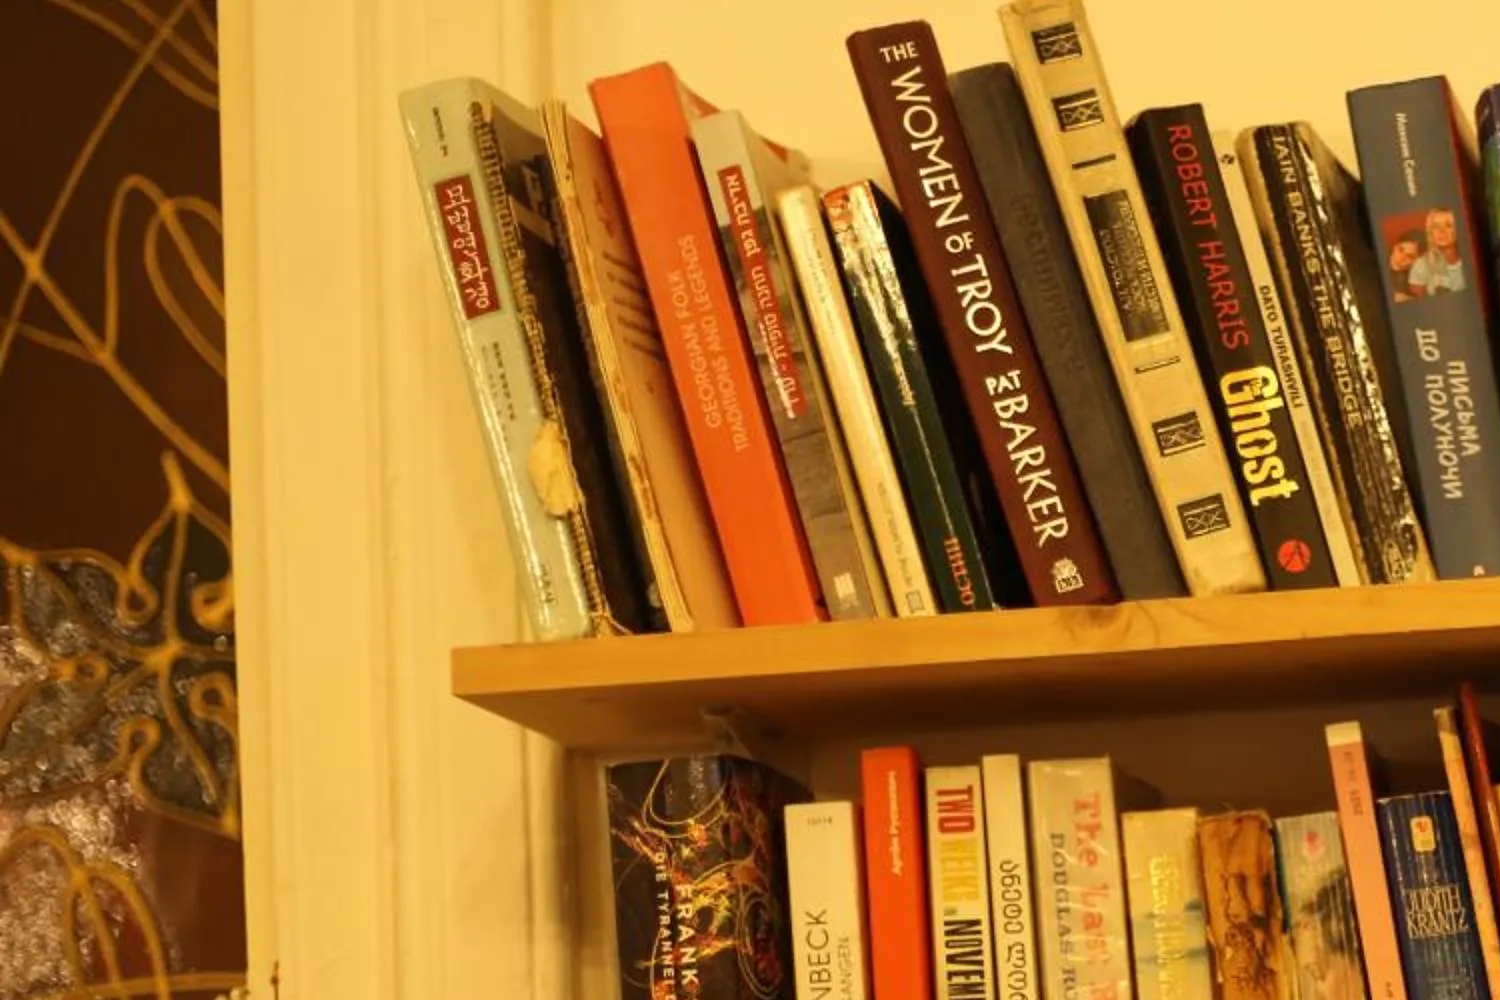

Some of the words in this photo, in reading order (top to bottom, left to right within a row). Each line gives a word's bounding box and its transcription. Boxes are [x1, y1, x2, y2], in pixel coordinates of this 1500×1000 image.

[879, 40, 919, 64] THE
[885, 64, 971, 231] WOMEN
[676, 232, 713, 312] LEGENDS
[943, 229, 977, 255] OF
[1162, 120, 1219, 234] ROBERT
[1193, 236, 1252, 352] HARRIS
[1271, 134, 1298, 185] IAIN
[1286, 189, 1323, 274] BANKS
[1311, 282, 1337, 329] THE
[1324, 334, 1364, 430] BRIDGE
[664, 268, 694, 319] FOLK
[700, 314, 724, 353] AND
[947, 250, 1014, 363] TROY
[679, 322, 723, 430] GEORGIAN
[984, 367, 1025, 398] PAT
[1257, 283, 1278, 323] DATO
[1269, 325, 1303, 409] TURASHVILI
[1413, 324, 1442, 364] ДО
[709, 353, 752, 452] TRADITIONS
[1214, 361, 1309, 507] Ghost
[1421, 371, 1465, 500] ПОЛУНОЧИ
[1443, 358, 1483, 457] ПИСЬМА
[991, 389, 1073, 549] BARKER
[935, 784, 975, 834] TWO
[1071, 792, 1104, 867] The
[653, 851, 668, 882] DIE
[1049, 831, 1075, 955] DOUGLAS
[656, 890, 675, 985] TYRANNEI
[674, 882, 701, 985] FRANK
